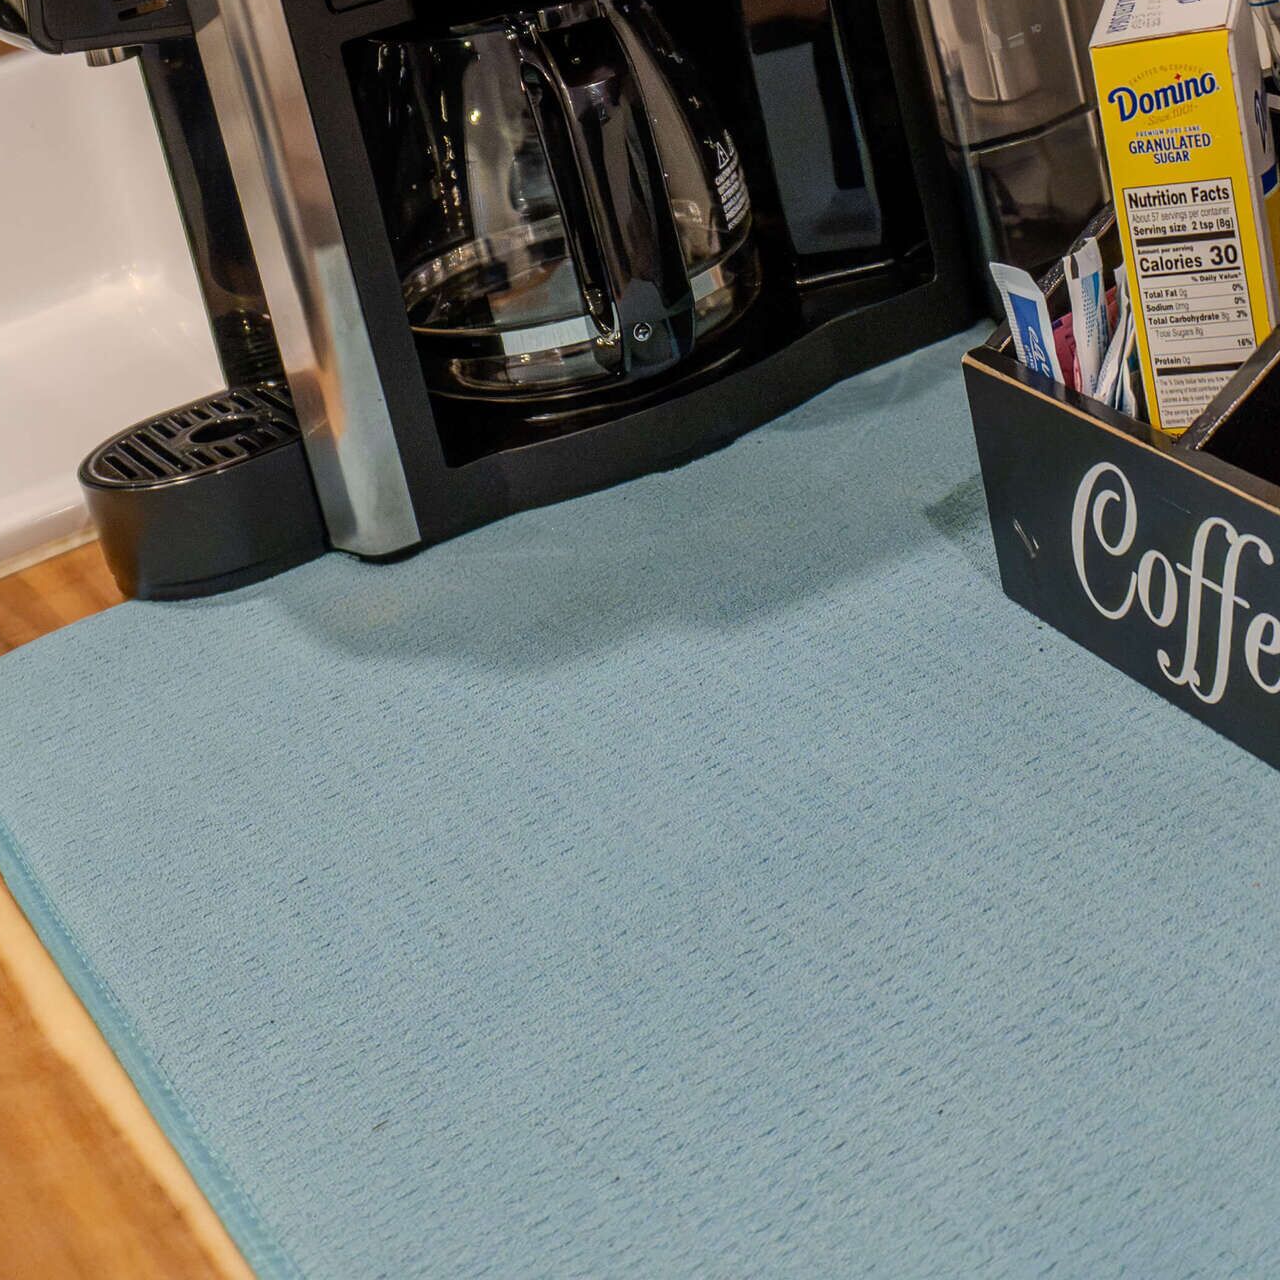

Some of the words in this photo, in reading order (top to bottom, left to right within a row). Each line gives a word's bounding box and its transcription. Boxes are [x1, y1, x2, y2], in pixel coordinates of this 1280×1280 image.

[1108, 72, 1217, 122] Domino
[1135, 128, 1164, 137] PREMIUM
[1128, 133, 1212, 155] GRANULATED
[1153, 151, 1191, 165] SUGAR
[1128, 189, 1187, 209] Nutrition
[1191, 185, 1230, 202] Facts
[1132, 213, 1151, 224] About
[1161, 210, 1187, 222] servings
[1189, 209, 1199, 220] per
[1200, 206, 1230, 217] container
[1133, 224, 1167, 236] Serving
[1169, 222, 1187, 233] size
[1191, 220, 1198, 230] 2
[1200, 219, 1214, 231] tsp
[1216, 217, 1234, 229] (8g)
[1140, 254, 1202, 272] Calories
[1209, 244, 1238, 265] 30
[1199, 273, 1217, 282] Daily
[1144, 290, 1164, 299] Total
[1165, 288, 1178, 298] Fat
[1232, 283, 1244, 291] 0%
[1146, 303, 1174, 312] Sodium
[1148, 316, 1168, 326] Total
[1169, 312, 1220, 325] Carbohydrate
[1172, 327, 1194, 338] Sugars
[1155, 355, 1181, 365] Protein
